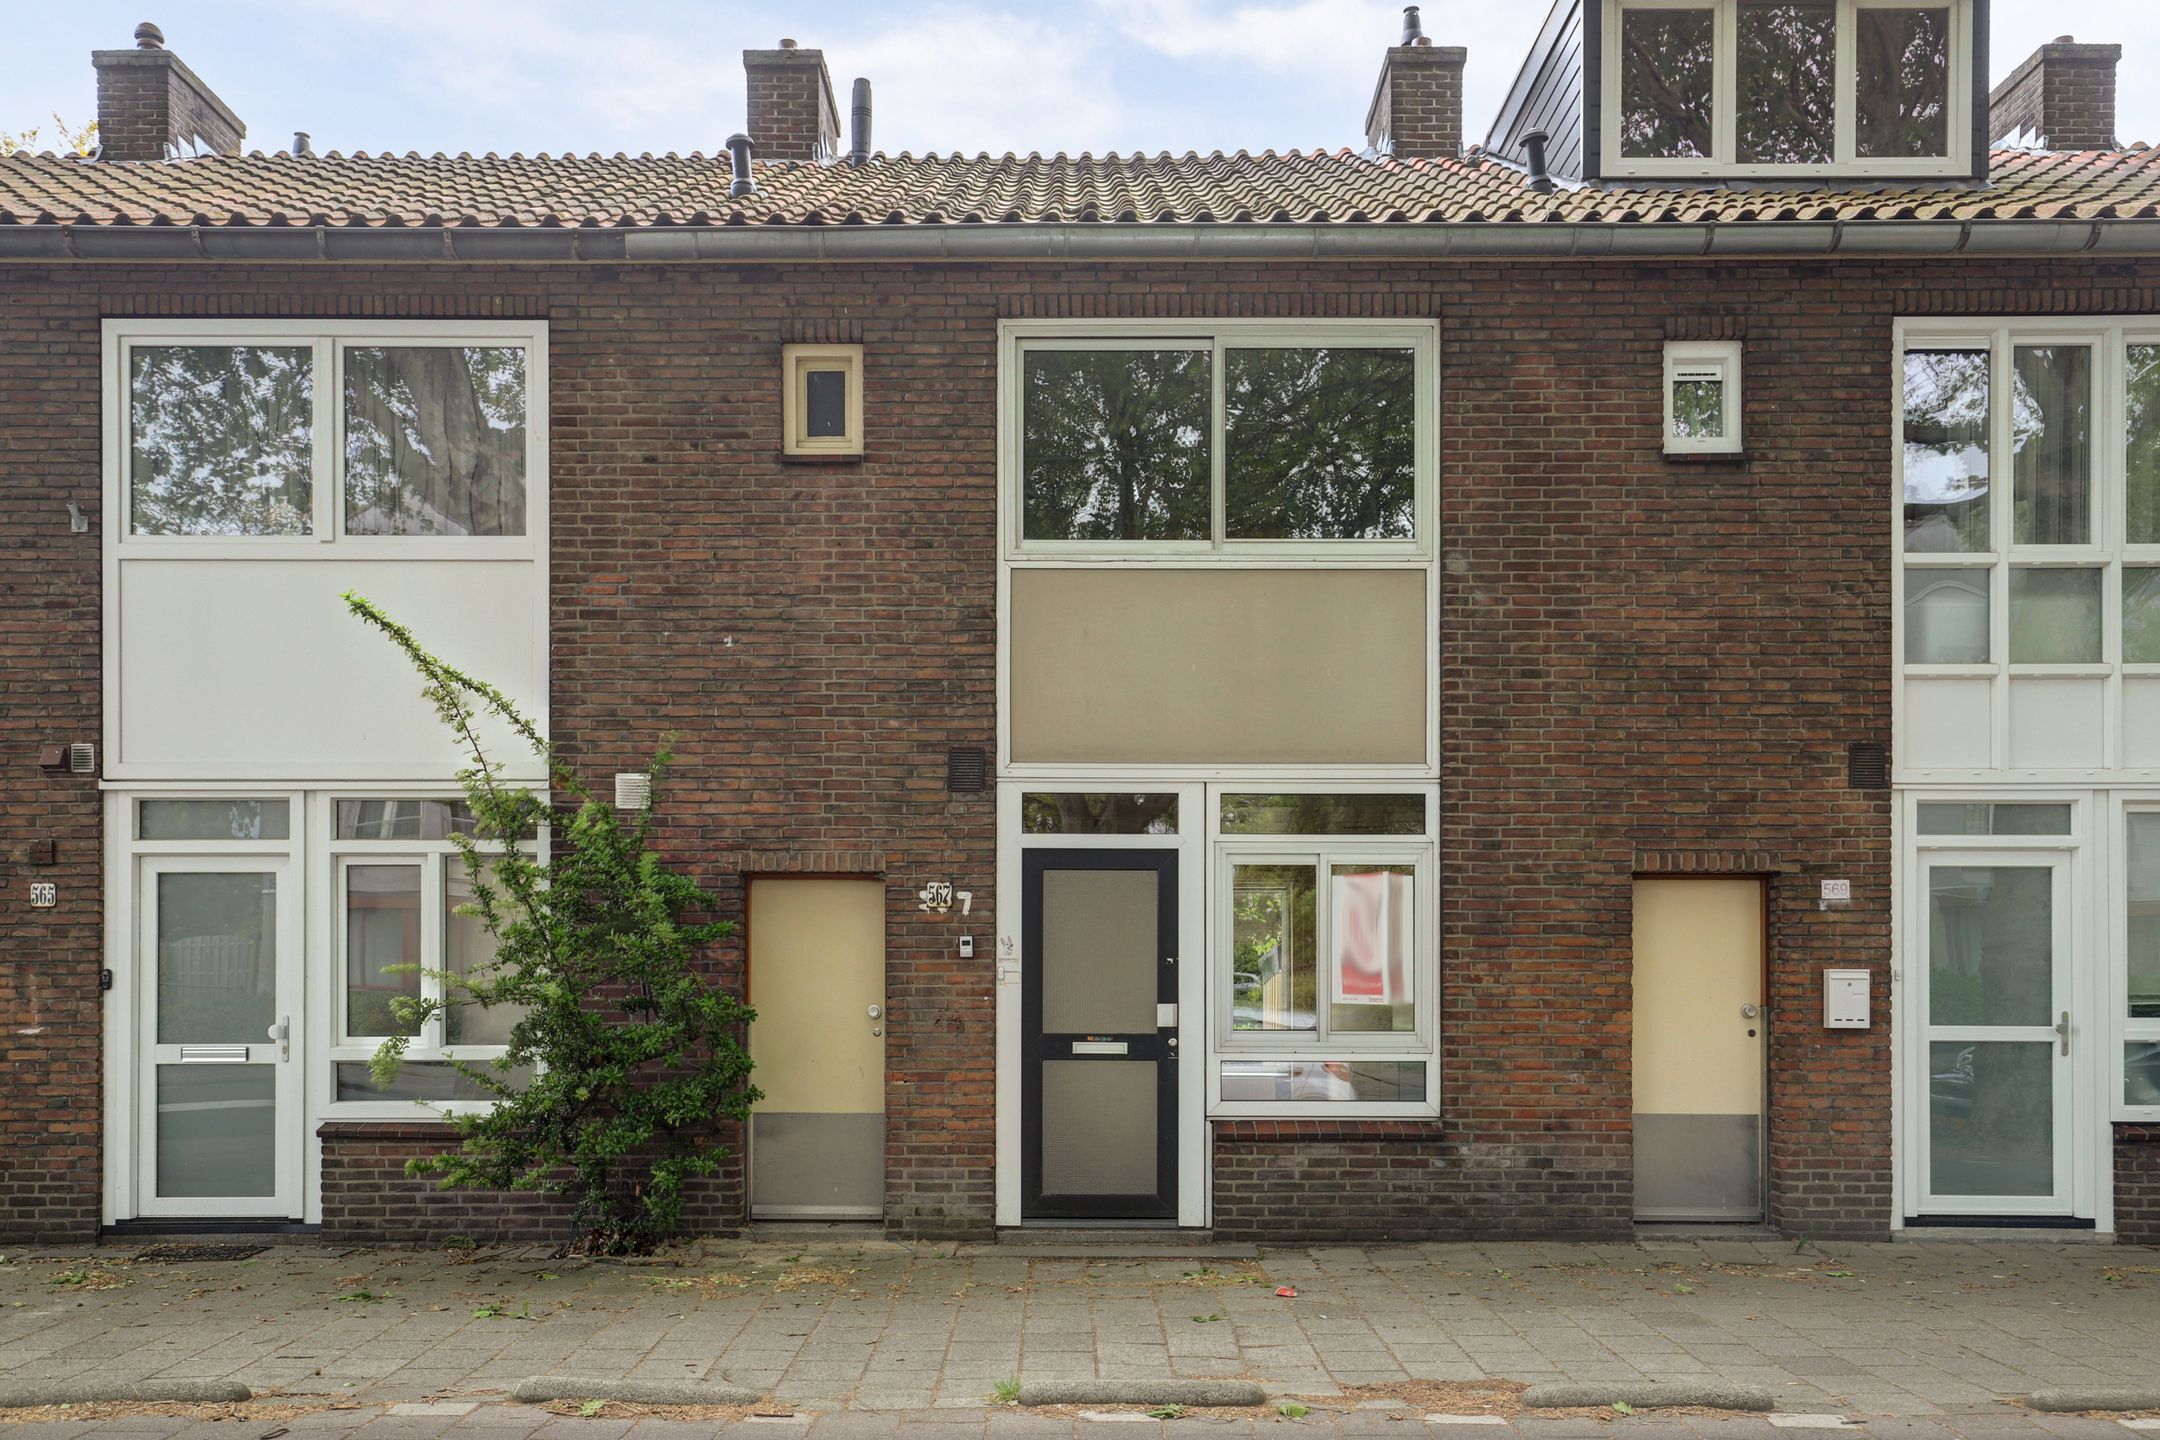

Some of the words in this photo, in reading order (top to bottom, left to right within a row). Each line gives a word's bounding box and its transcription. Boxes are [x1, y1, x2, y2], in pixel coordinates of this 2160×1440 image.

[31, 885, 55, 905] 565
[928, 885, 951, 905] 567
[1823, 883, 1848, 896] 569
